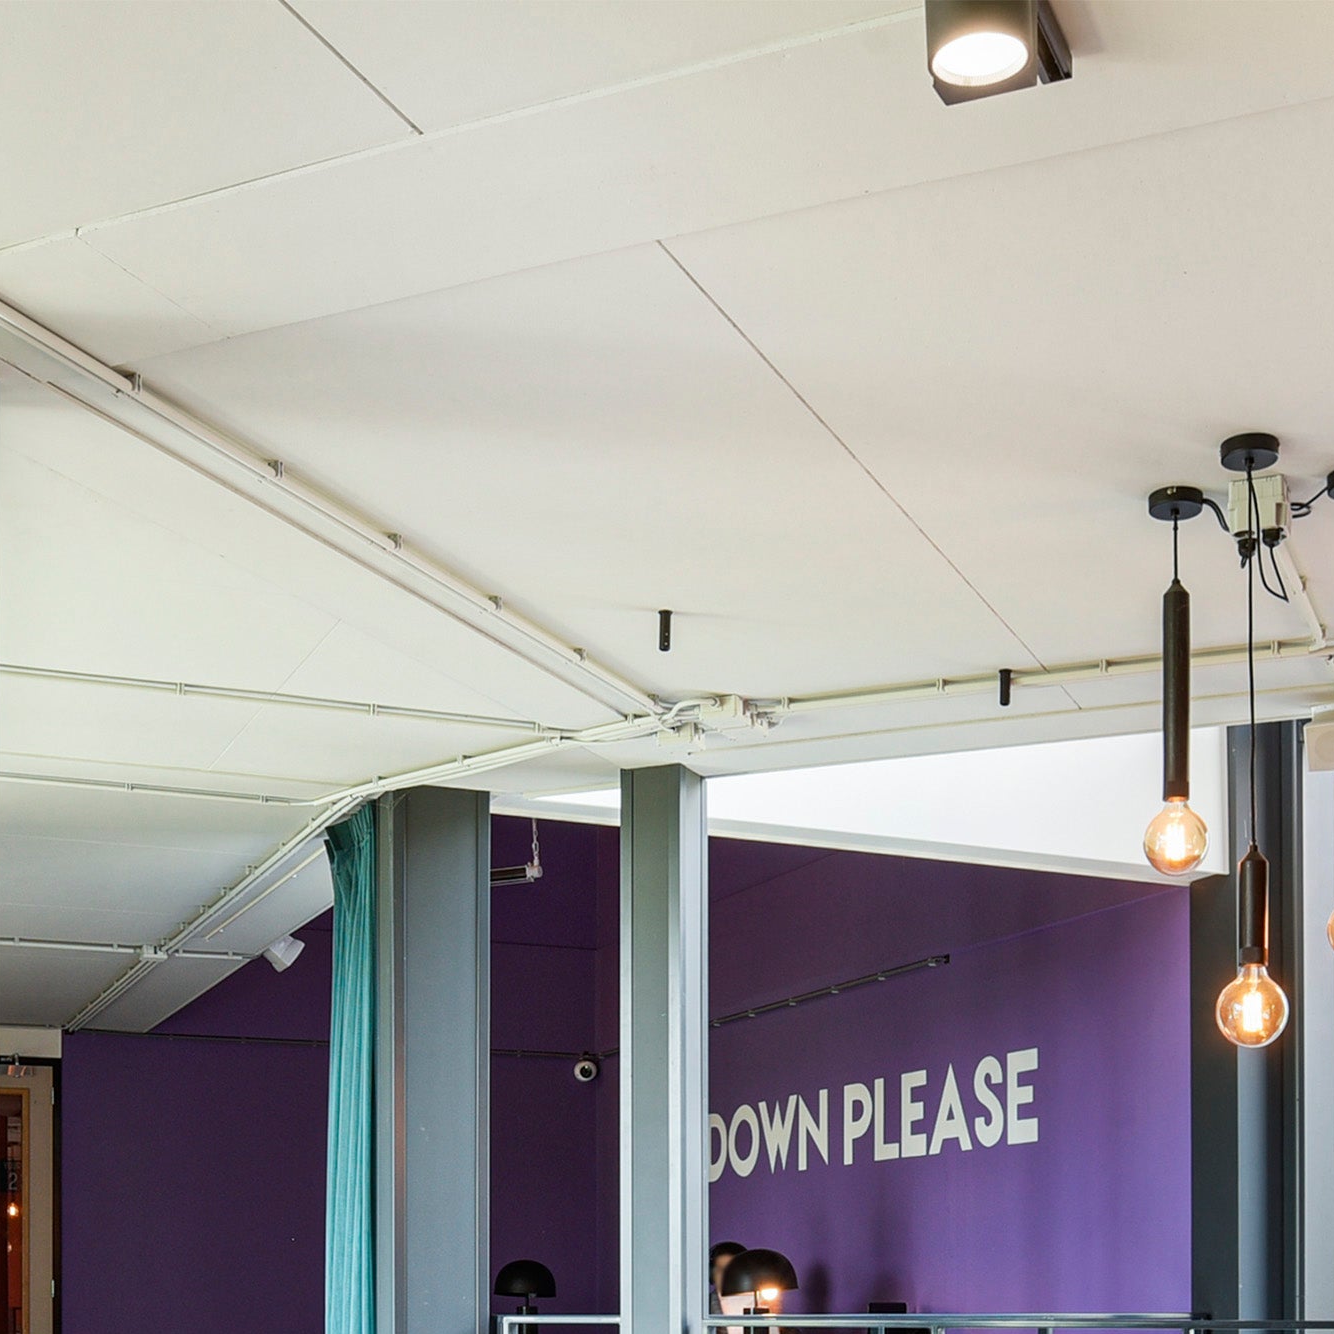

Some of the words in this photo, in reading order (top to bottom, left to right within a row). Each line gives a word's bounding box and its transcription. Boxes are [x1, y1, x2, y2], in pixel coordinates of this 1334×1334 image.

[709, 1088, 829, 1183] DOWN
[843, 1047, 1039, 1166] PLEASE
[8, 1172, 18, 1190] 2
